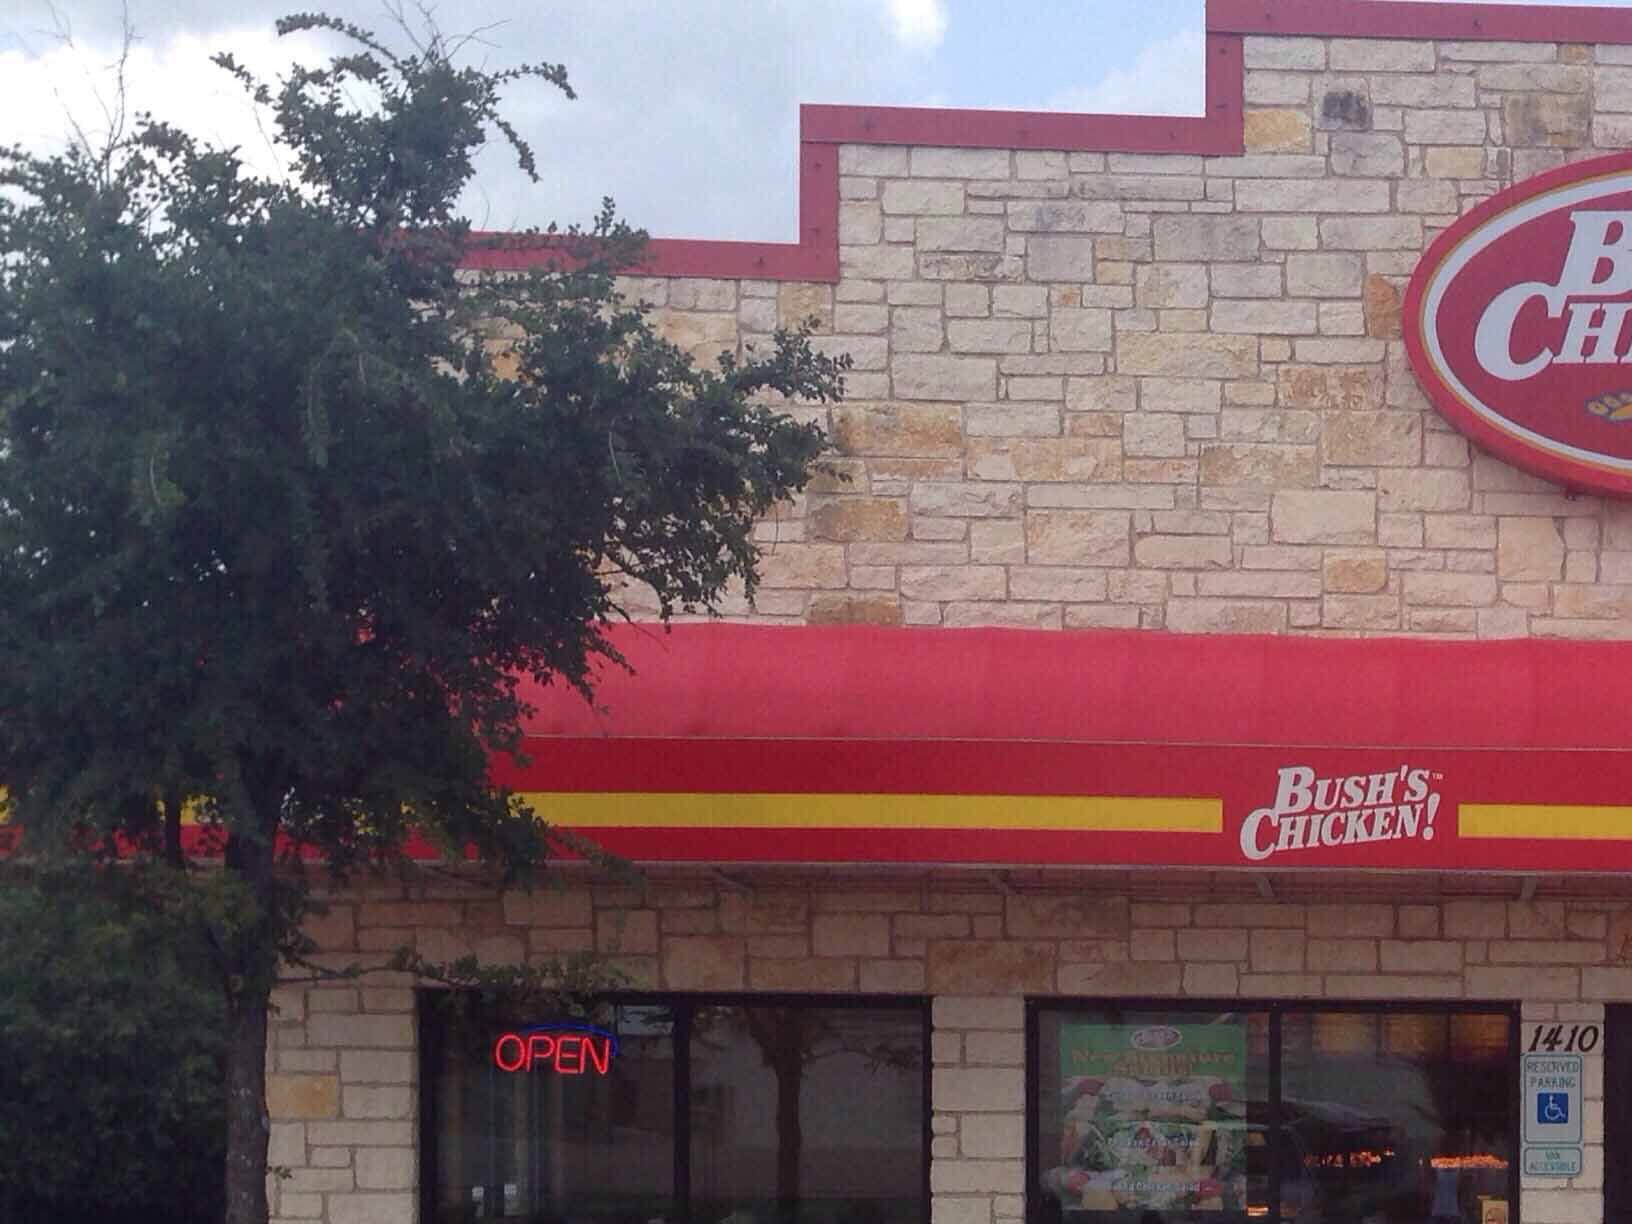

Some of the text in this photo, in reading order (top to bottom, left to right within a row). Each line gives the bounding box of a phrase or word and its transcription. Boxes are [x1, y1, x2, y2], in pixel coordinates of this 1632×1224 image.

[1273, 764, 1430, 815] BUSH'S
[1239, 792, 1441, 861] CHICKEN!
[492, 1032, 612, 1075] OPEN
[1527, 1024, 1600, 1053] 1410
[1526, 1061, 1579, 1073] RESERVED
[1530, 1076, 1577, 1089] PARKING
